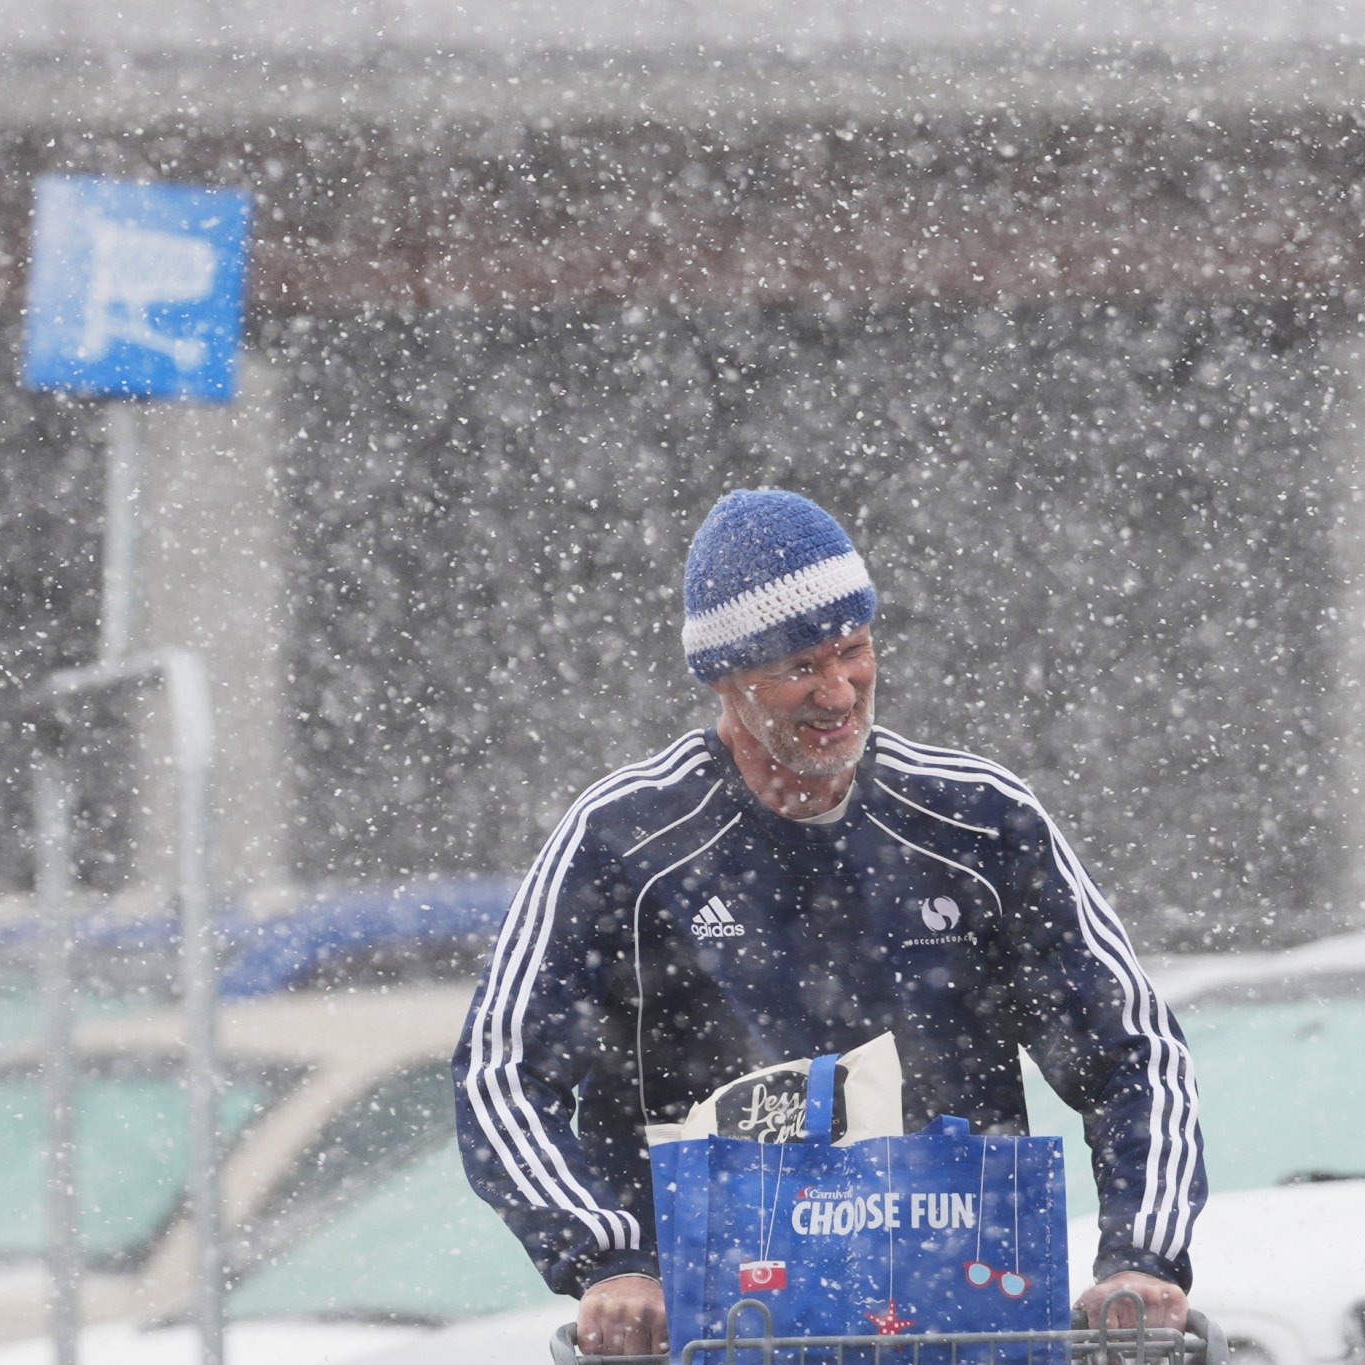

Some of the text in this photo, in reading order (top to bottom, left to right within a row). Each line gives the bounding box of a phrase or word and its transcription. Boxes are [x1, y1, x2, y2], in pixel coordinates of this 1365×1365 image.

[691, 922, 745, 937] adidas
[908, 934, 978, 945] soccerstop.cm
[738, 1083, 807, 1130] Less
[791, 1192, 974, 1236] CHOOSE FUN
